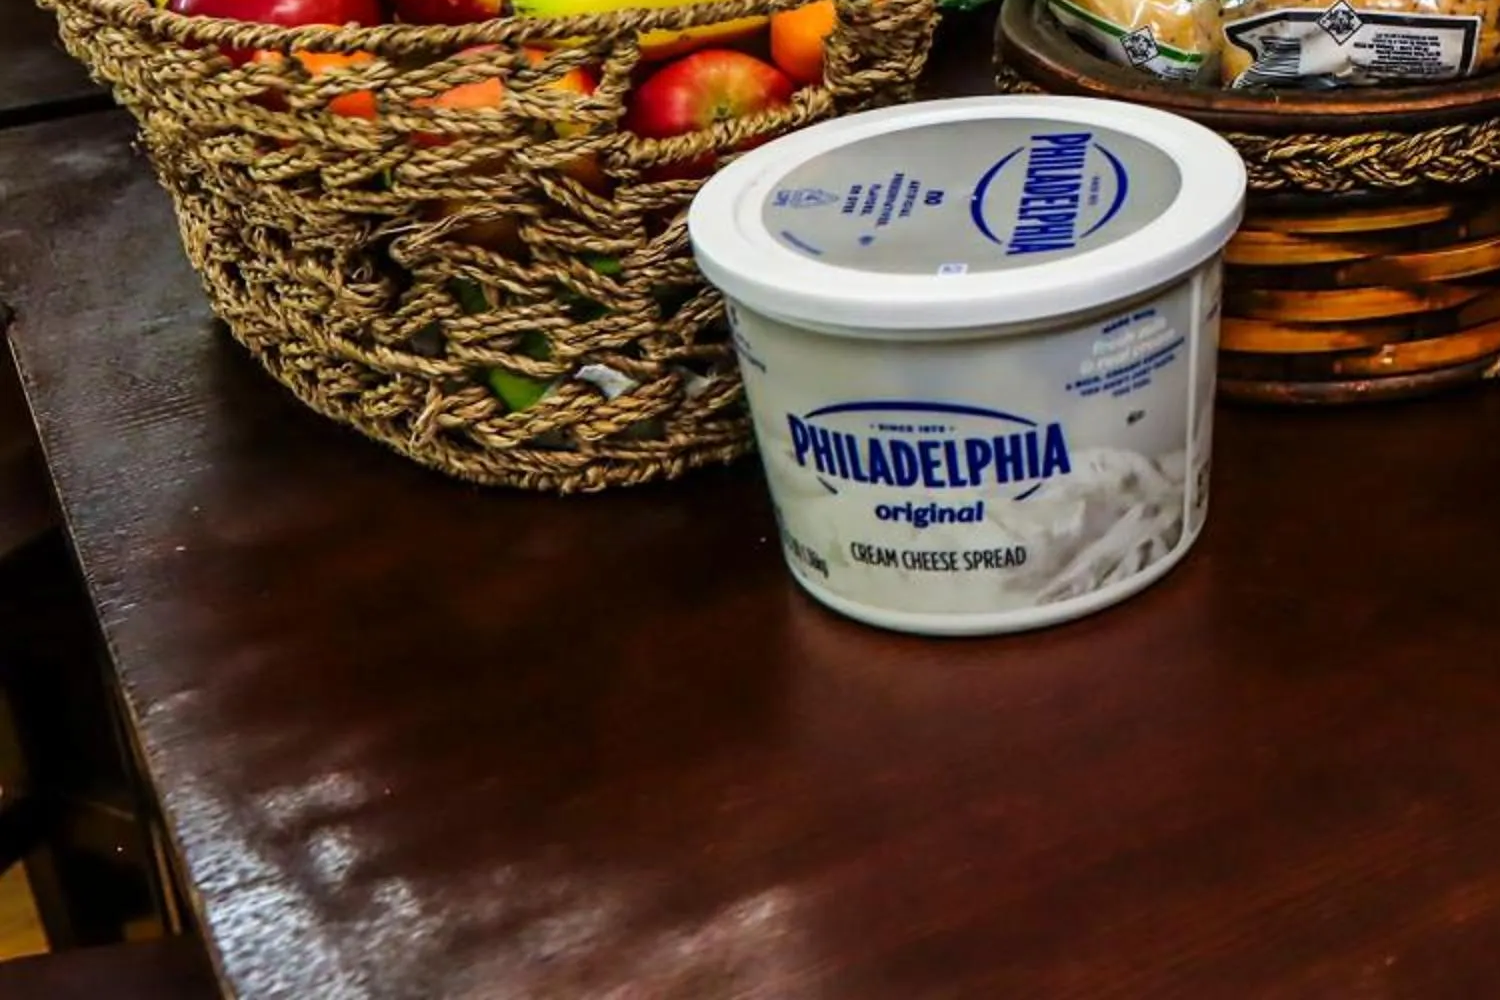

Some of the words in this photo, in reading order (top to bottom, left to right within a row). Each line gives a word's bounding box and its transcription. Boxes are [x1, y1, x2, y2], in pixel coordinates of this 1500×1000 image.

[1004, 132, 1093, 256] PHILADELPHIA
[787, 412, 1071, 489] PHILADELPHIA
[875, 500, 985, 530] original
[850, 542, 898, 570] CREAM
[901, 549, 959, 571] CHEESE
[963, 544, 1027, 571] SPREAD
